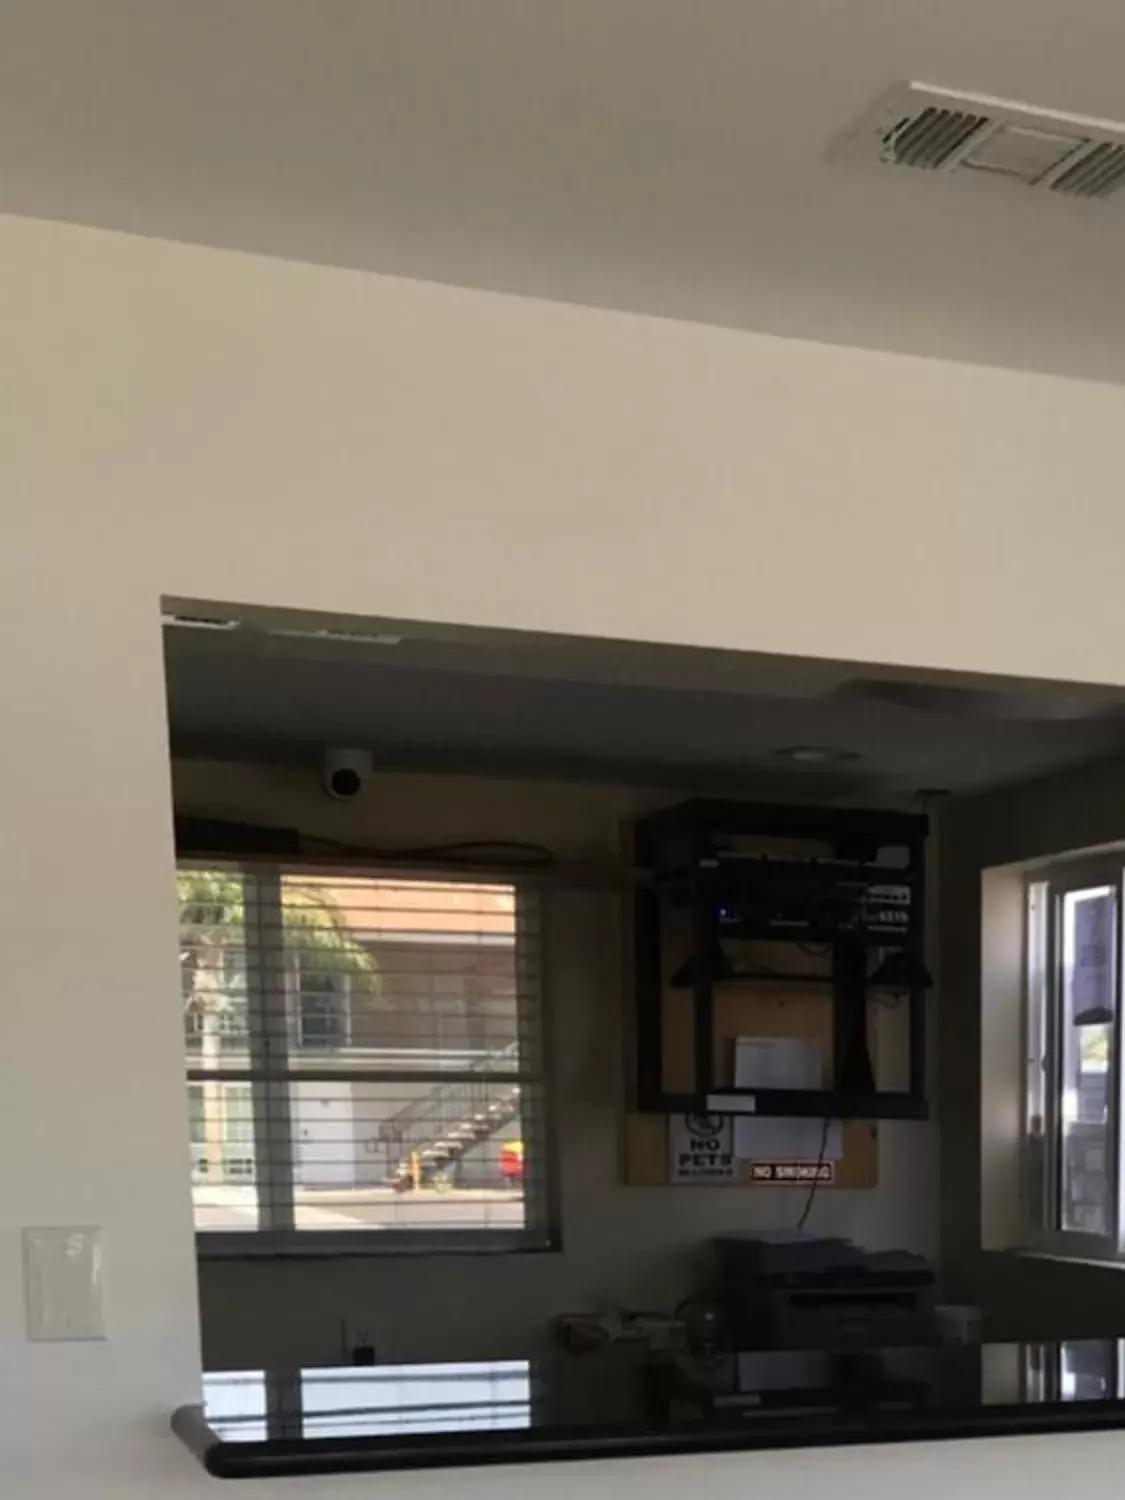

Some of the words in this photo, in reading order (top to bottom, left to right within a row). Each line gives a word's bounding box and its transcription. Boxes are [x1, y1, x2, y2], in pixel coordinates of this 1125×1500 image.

[690, 1138, 720, 1151] NO
[678, 1153, 733, 1166] PETS
[754, 1165, 773, 1179] NO
